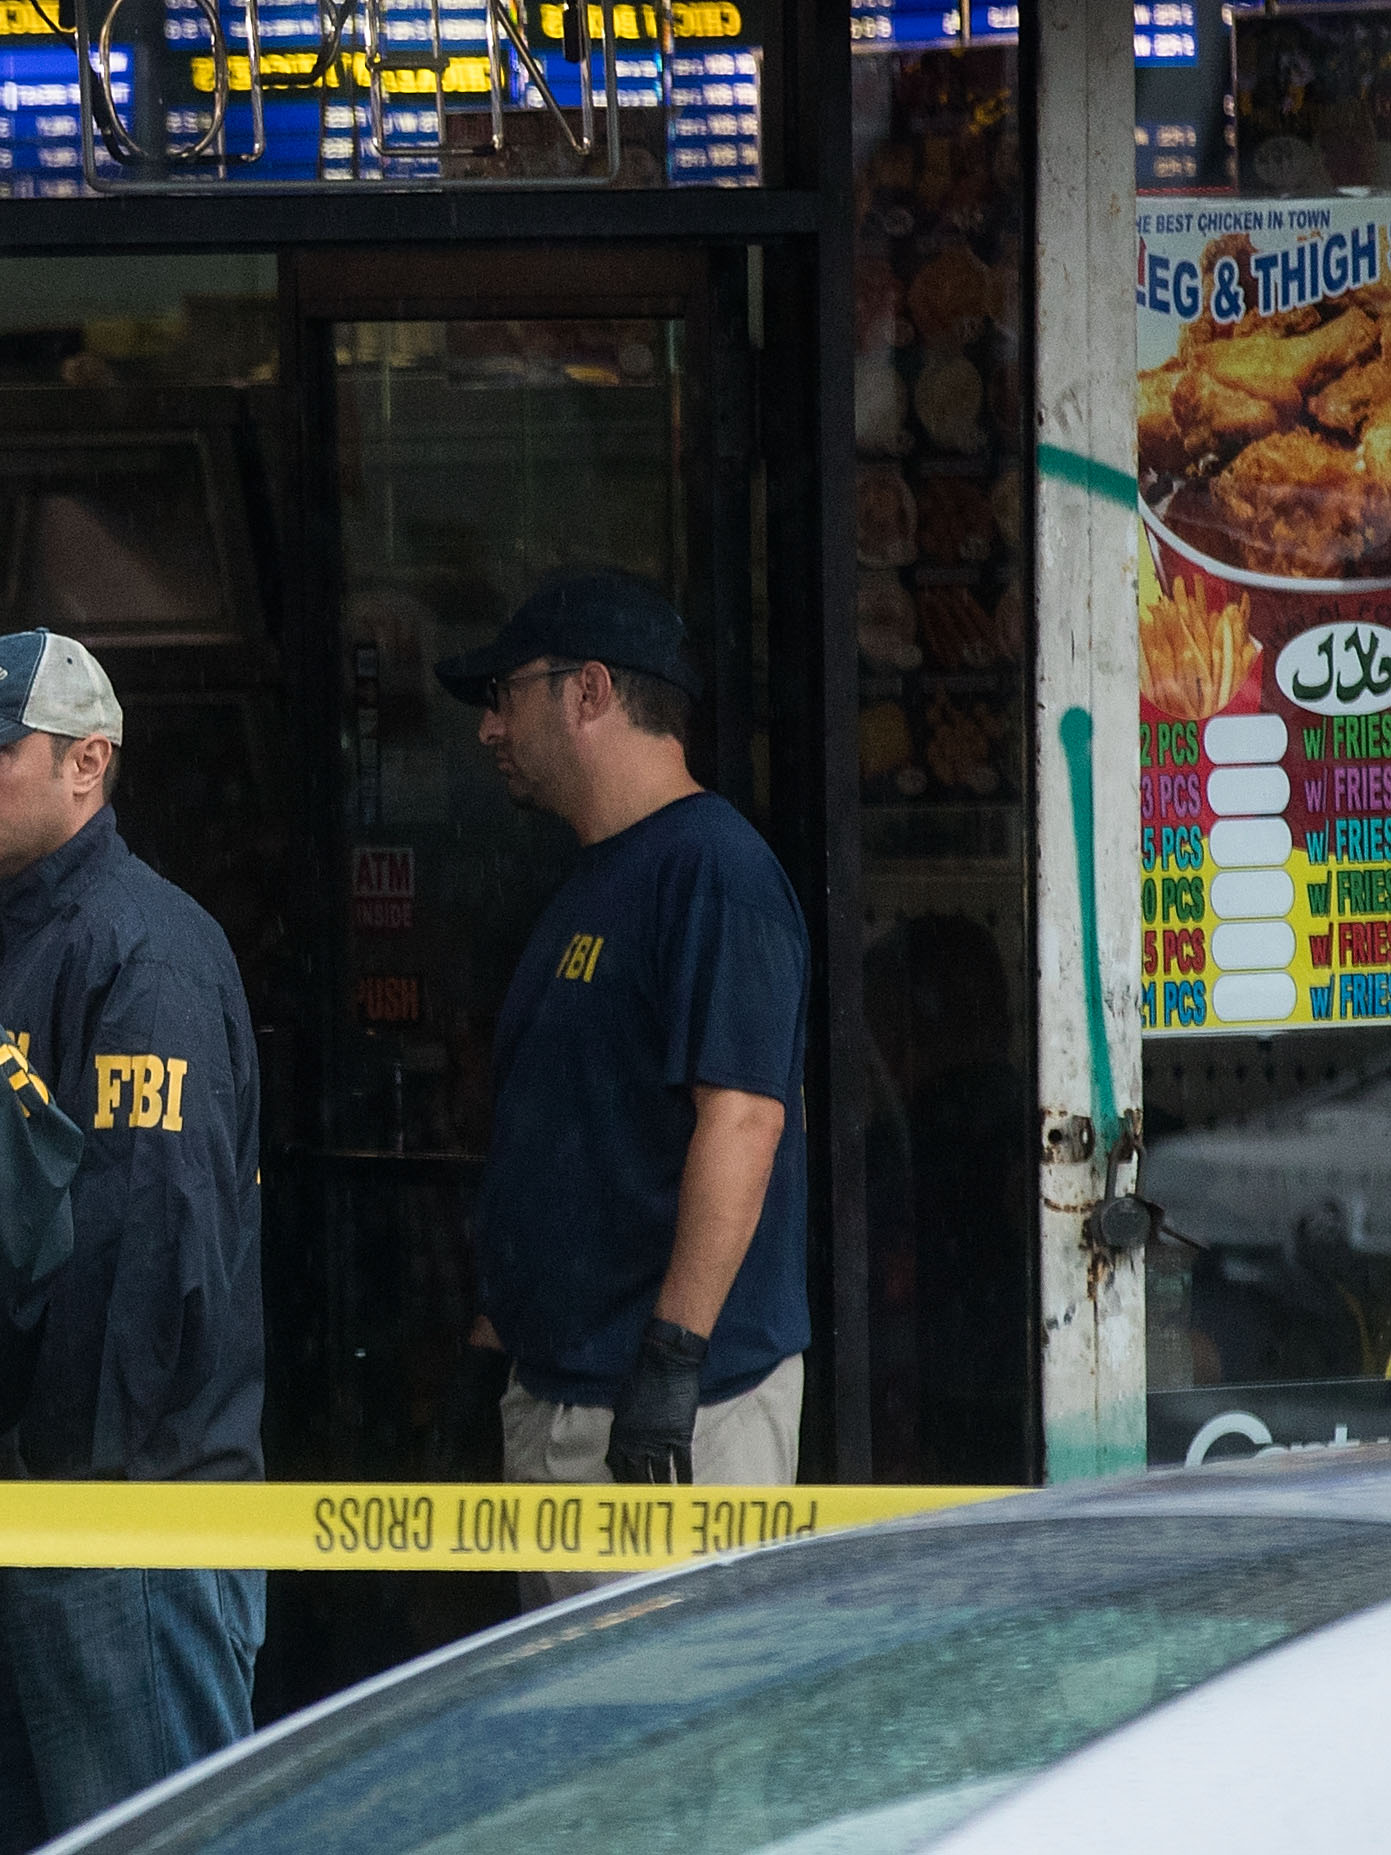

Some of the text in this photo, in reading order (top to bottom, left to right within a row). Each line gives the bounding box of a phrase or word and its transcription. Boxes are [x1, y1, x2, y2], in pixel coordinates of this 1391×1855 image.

[1136, 209, 1331, 234] HE BEST CHICKEN IN TOWN
[1136, 222, 1377, 320] EG & THIGH
[1158, 720, 1200, 767] PCS
[1159, 772, 1202, 819] PCS
[357, 851, 411, 892] ATM
[1161, 825, 1204, 871] PCS
[1141, 876, 1205, 925] 0 PCS
[555, 931, 605, 983] FBI
[1141, 928, 1206, 976] 5 PCS
[1163, 979, 1207, 1027] PCS
[93, 1053, 188, 1132] FBI
[314, 1494, 434, 1553] CROSS
[450, 1497, 520, 1554] NOT
[536, 1497, 582, 1554] DO
[597, 1500, 674, 1556] LINE
